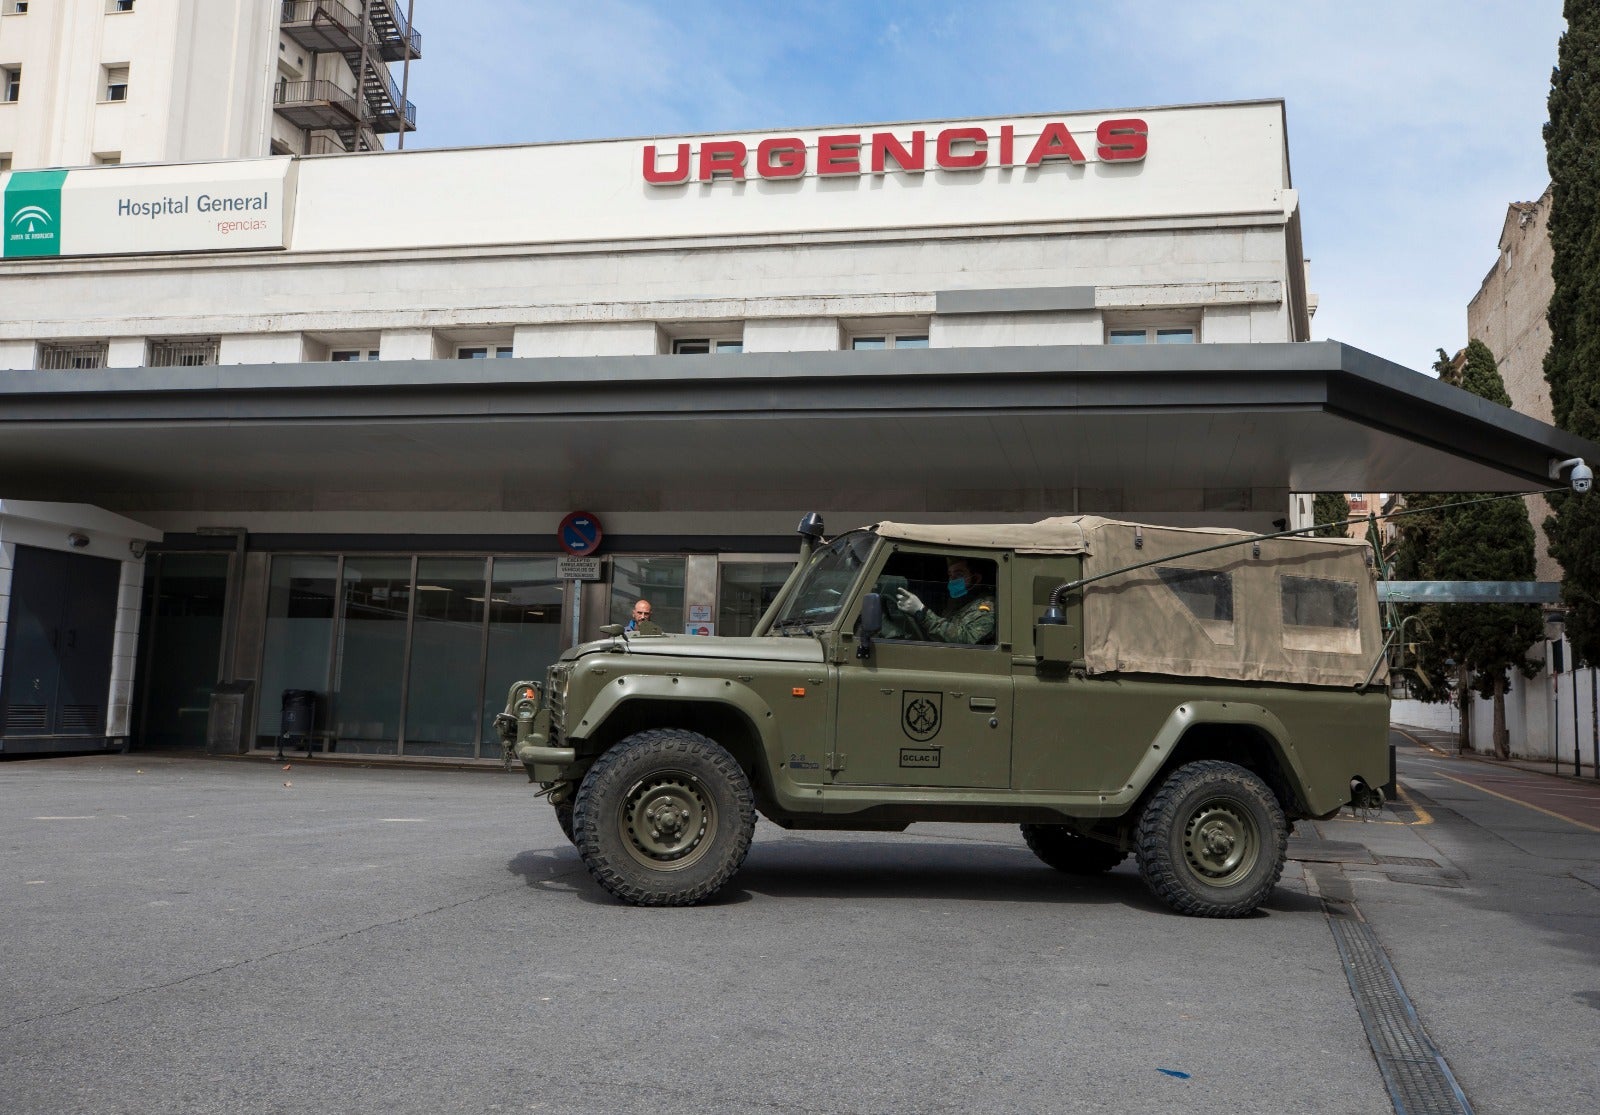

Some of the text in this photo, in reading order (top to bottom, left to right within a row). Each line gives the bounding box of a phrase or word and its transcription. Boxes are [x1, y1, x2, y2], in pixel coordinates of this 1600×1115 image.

[642, 118, 1149, 186] URGENCIAS
[118, 191, 268, 219] Hospital General
